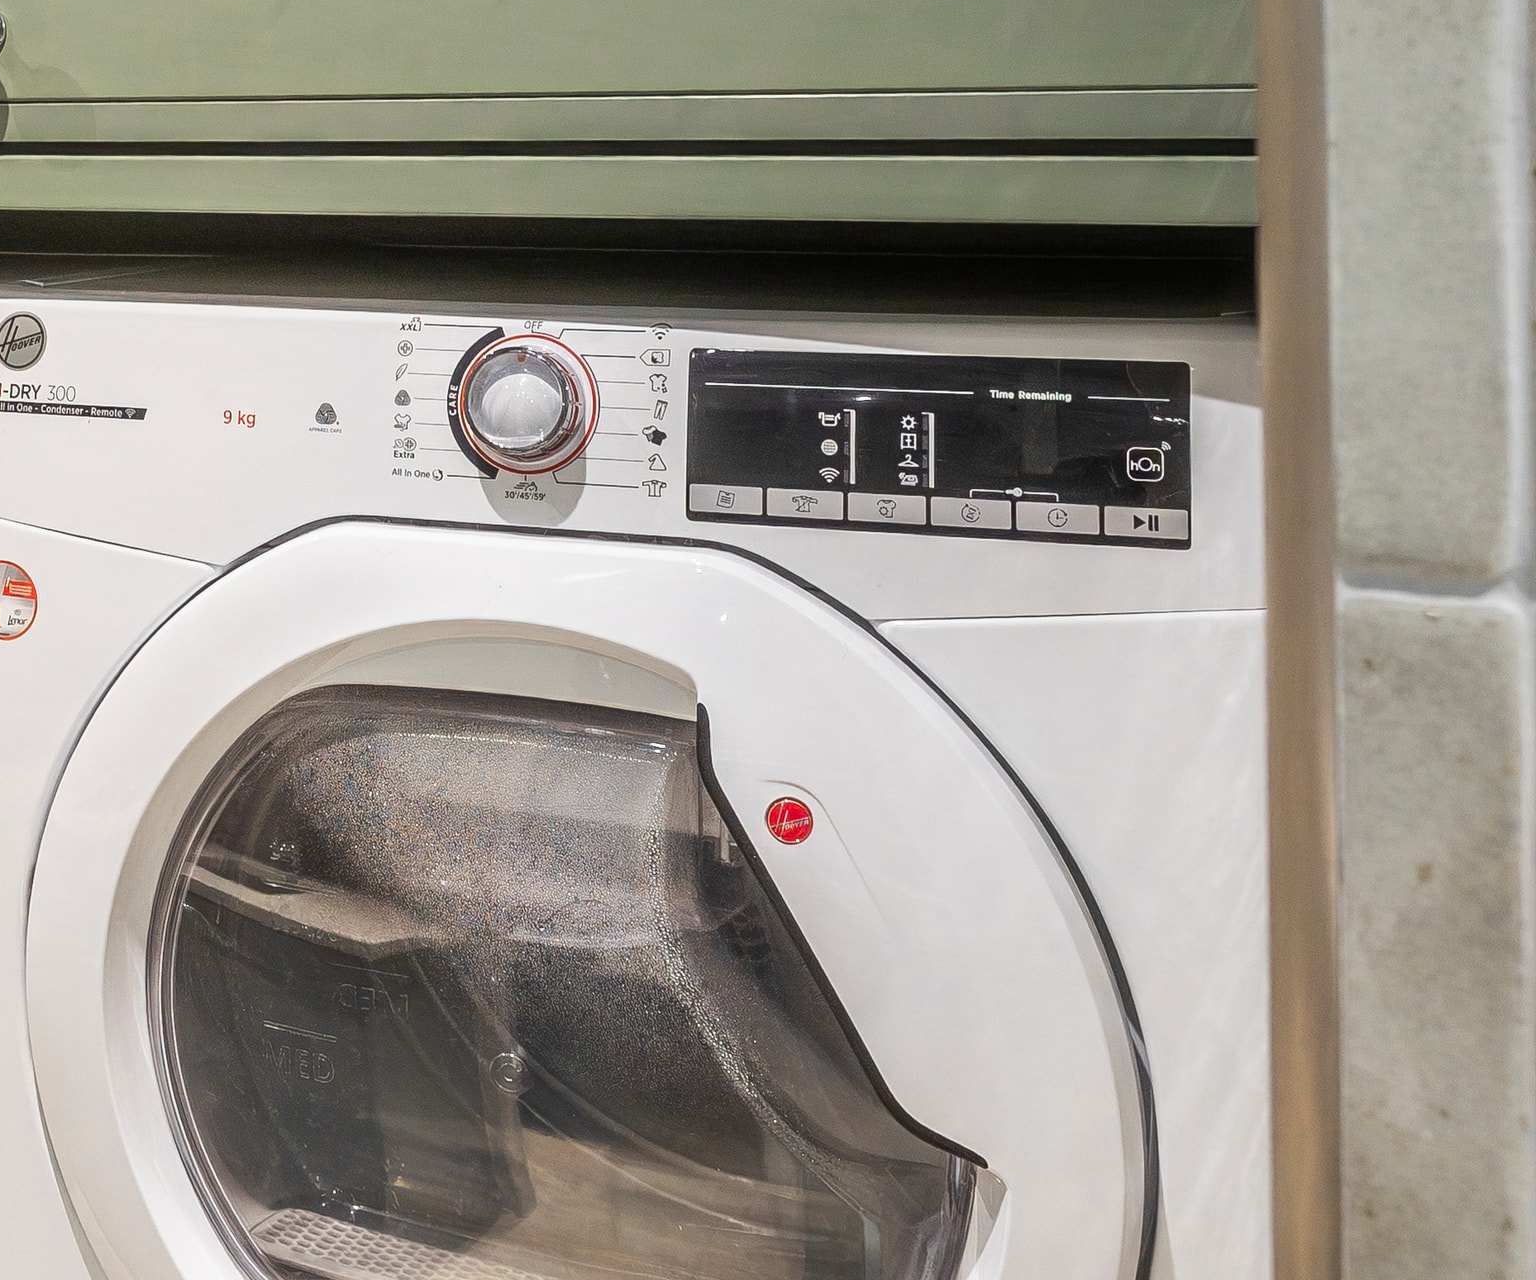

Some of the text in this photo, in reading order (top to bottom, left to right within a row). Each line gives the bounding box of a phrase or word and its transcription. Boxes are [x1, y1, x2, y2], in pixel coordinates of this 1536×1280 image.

[524, 320, 543, 330] OFF
[46, 384, 76, 402] 300
[448, 384, 458, 416] CARE
[990, 390, 1072, 402] Time Remaining
[16, 404, 32, 412] One
[40, 405, 84, 416] Condenser
[90, 408, 123, 418] Remote
[223, 410, 256, 428] 9 kg
[394, 450, 415, 459] Extra
[1130, 457, 1160, 472] hOn
[404, 470, 412, 478] In
[414, 470, 430, 478] One
